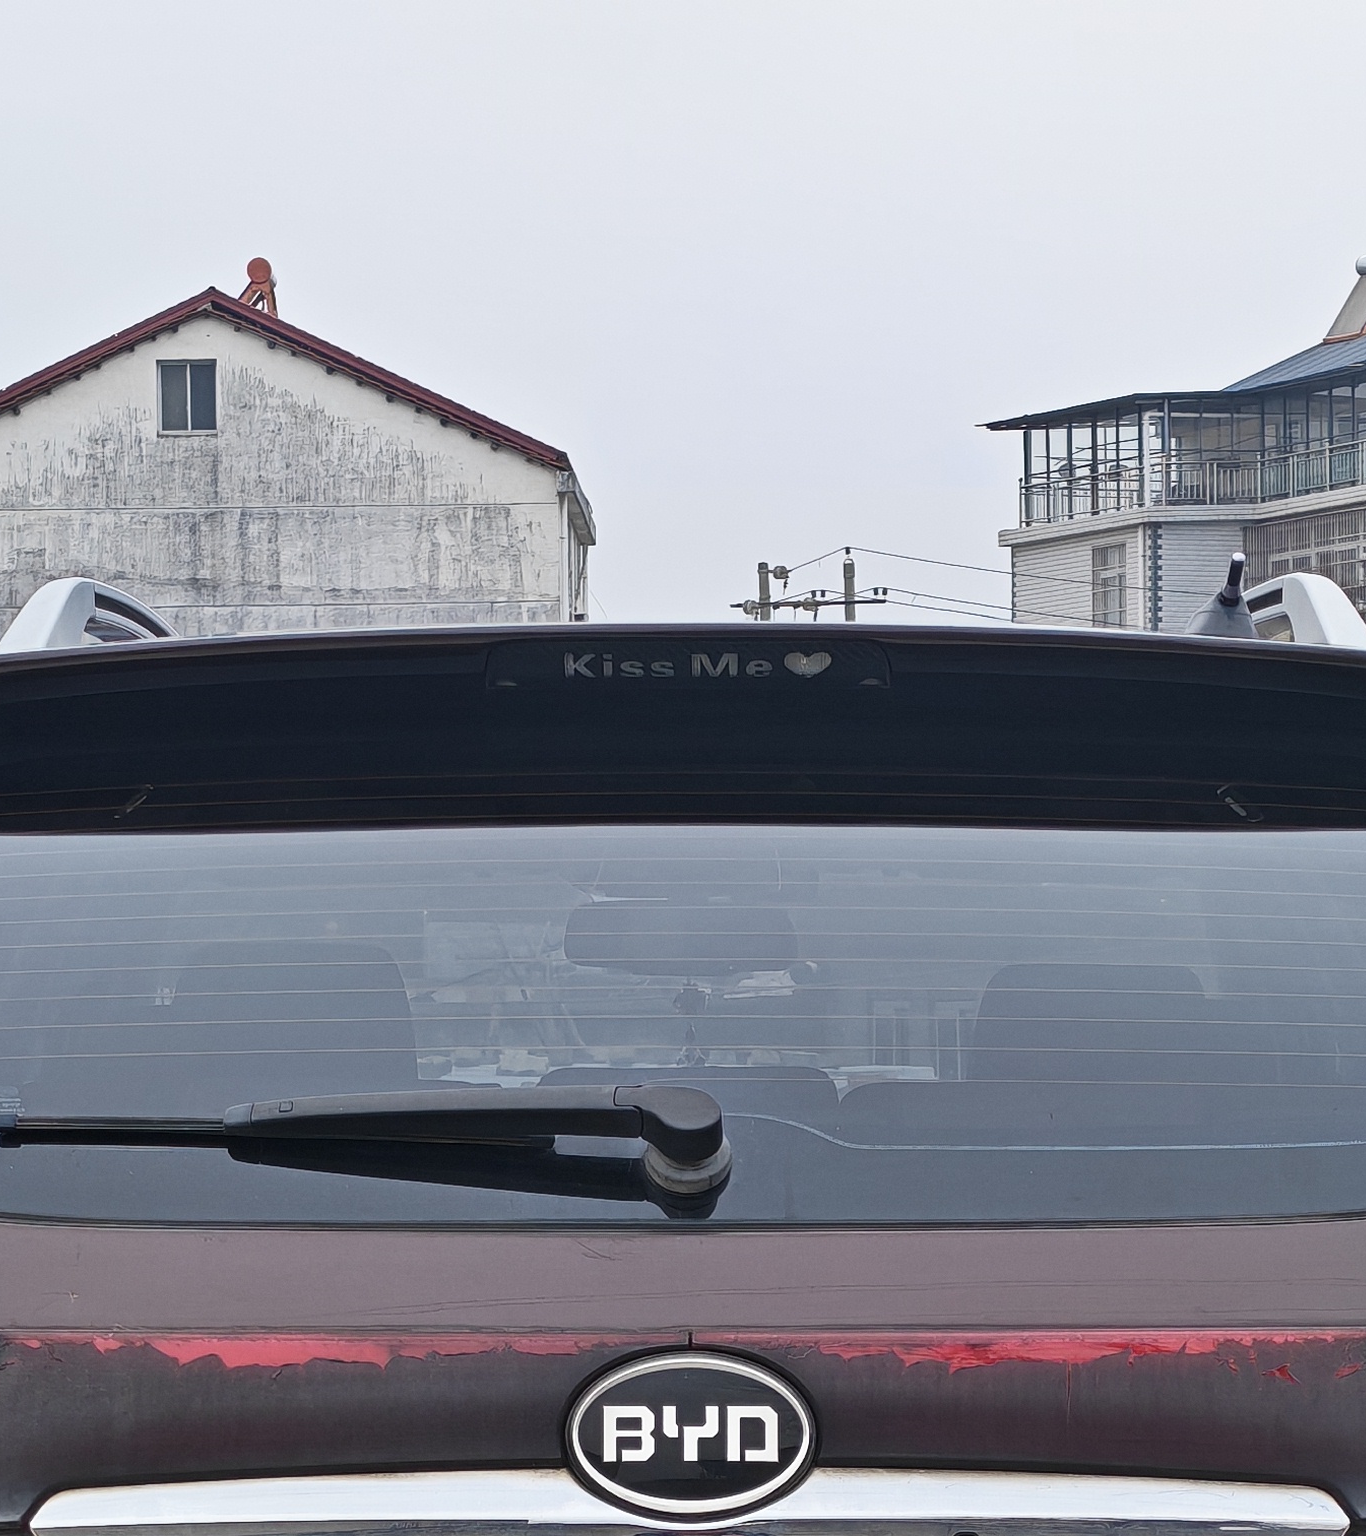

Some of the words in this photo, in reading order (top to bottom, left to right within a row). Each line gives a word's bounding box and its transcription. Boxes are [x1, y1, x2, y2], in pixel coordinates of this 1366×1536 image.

[564, 652, 675, 678] Kiss
[691, 652, 773, 678] Me
[603, 1405, 779, 1462] BYD
